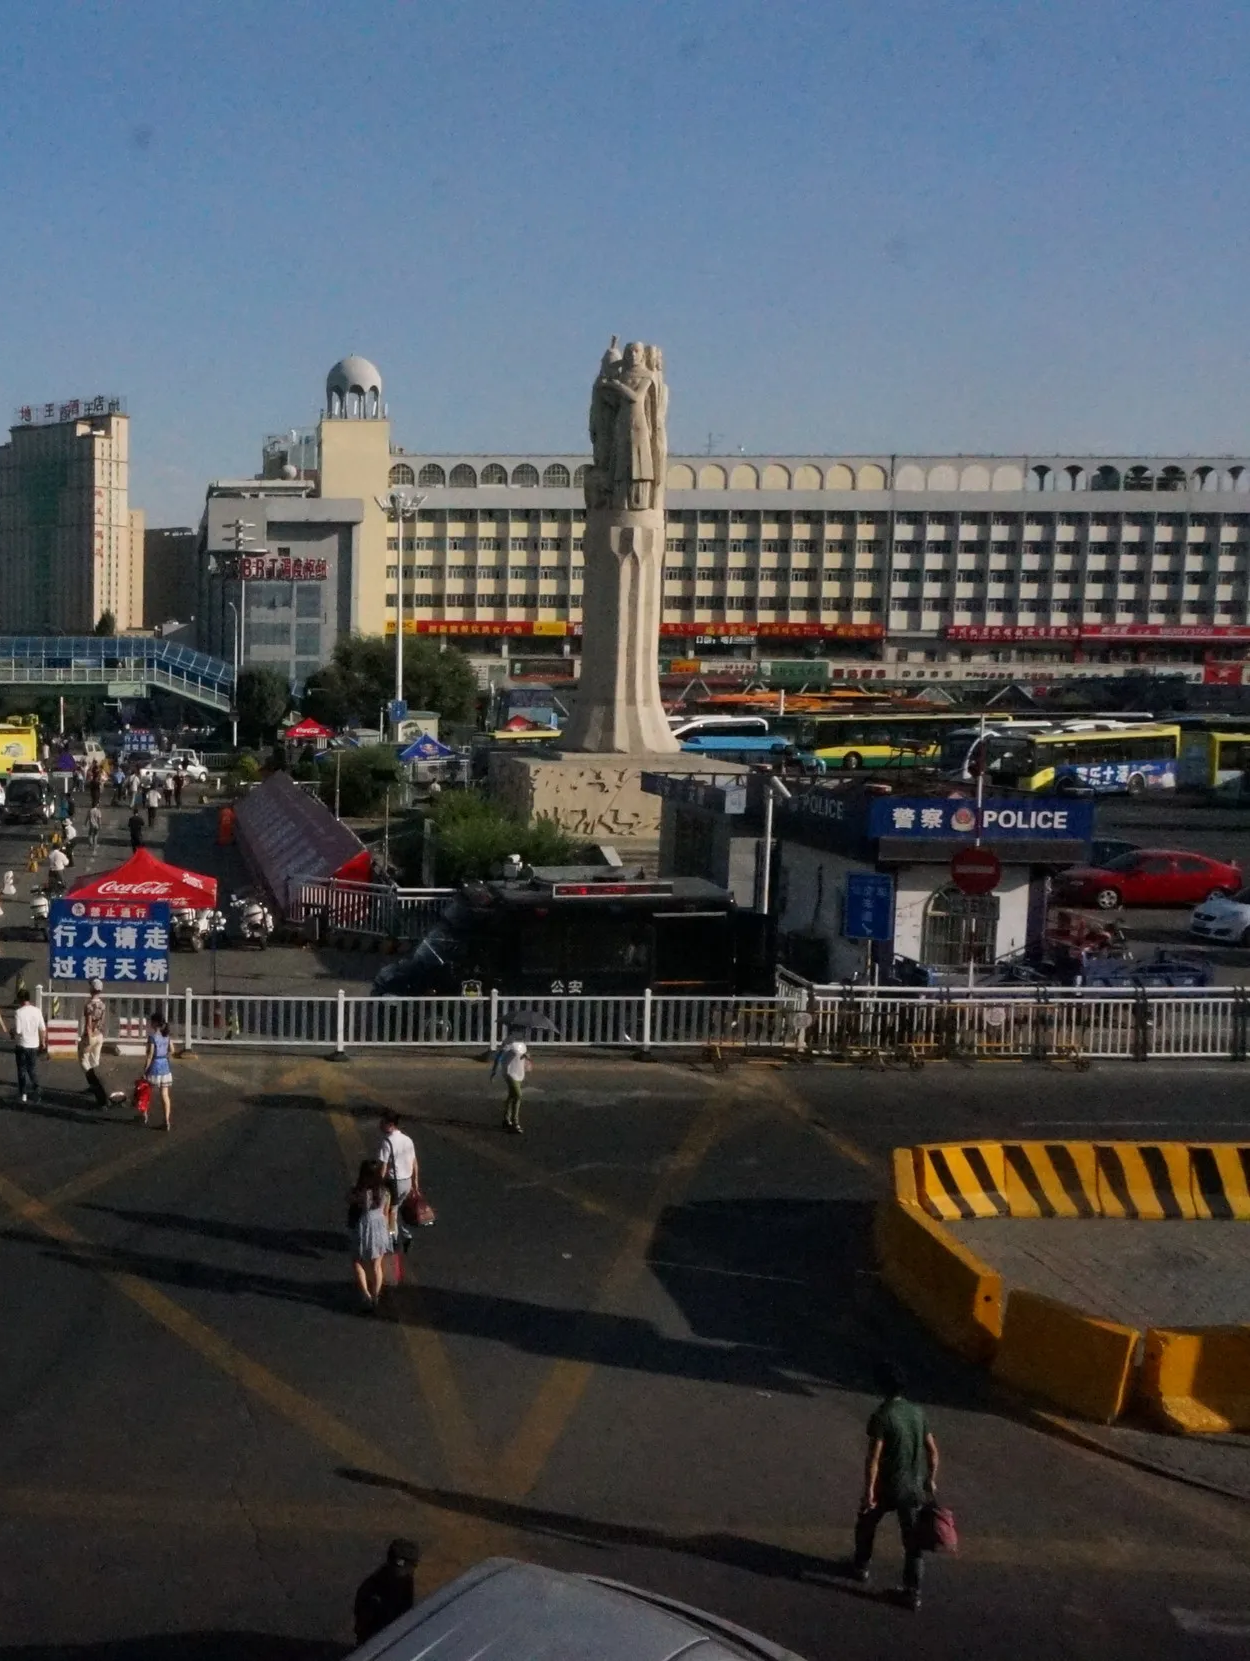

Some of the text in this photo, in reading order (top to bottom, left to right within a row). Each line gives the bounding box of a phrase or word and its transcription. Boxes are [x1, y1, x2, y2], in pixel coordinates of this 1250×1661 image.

[892, 807, 943, 829] 警察
[983, 810, 1068, 829] POLICE
[53, 925, 168, 950] 行人请走
[53, 956, 168, 981] 过街天桥
[551, 980, 583, 994] 公安
